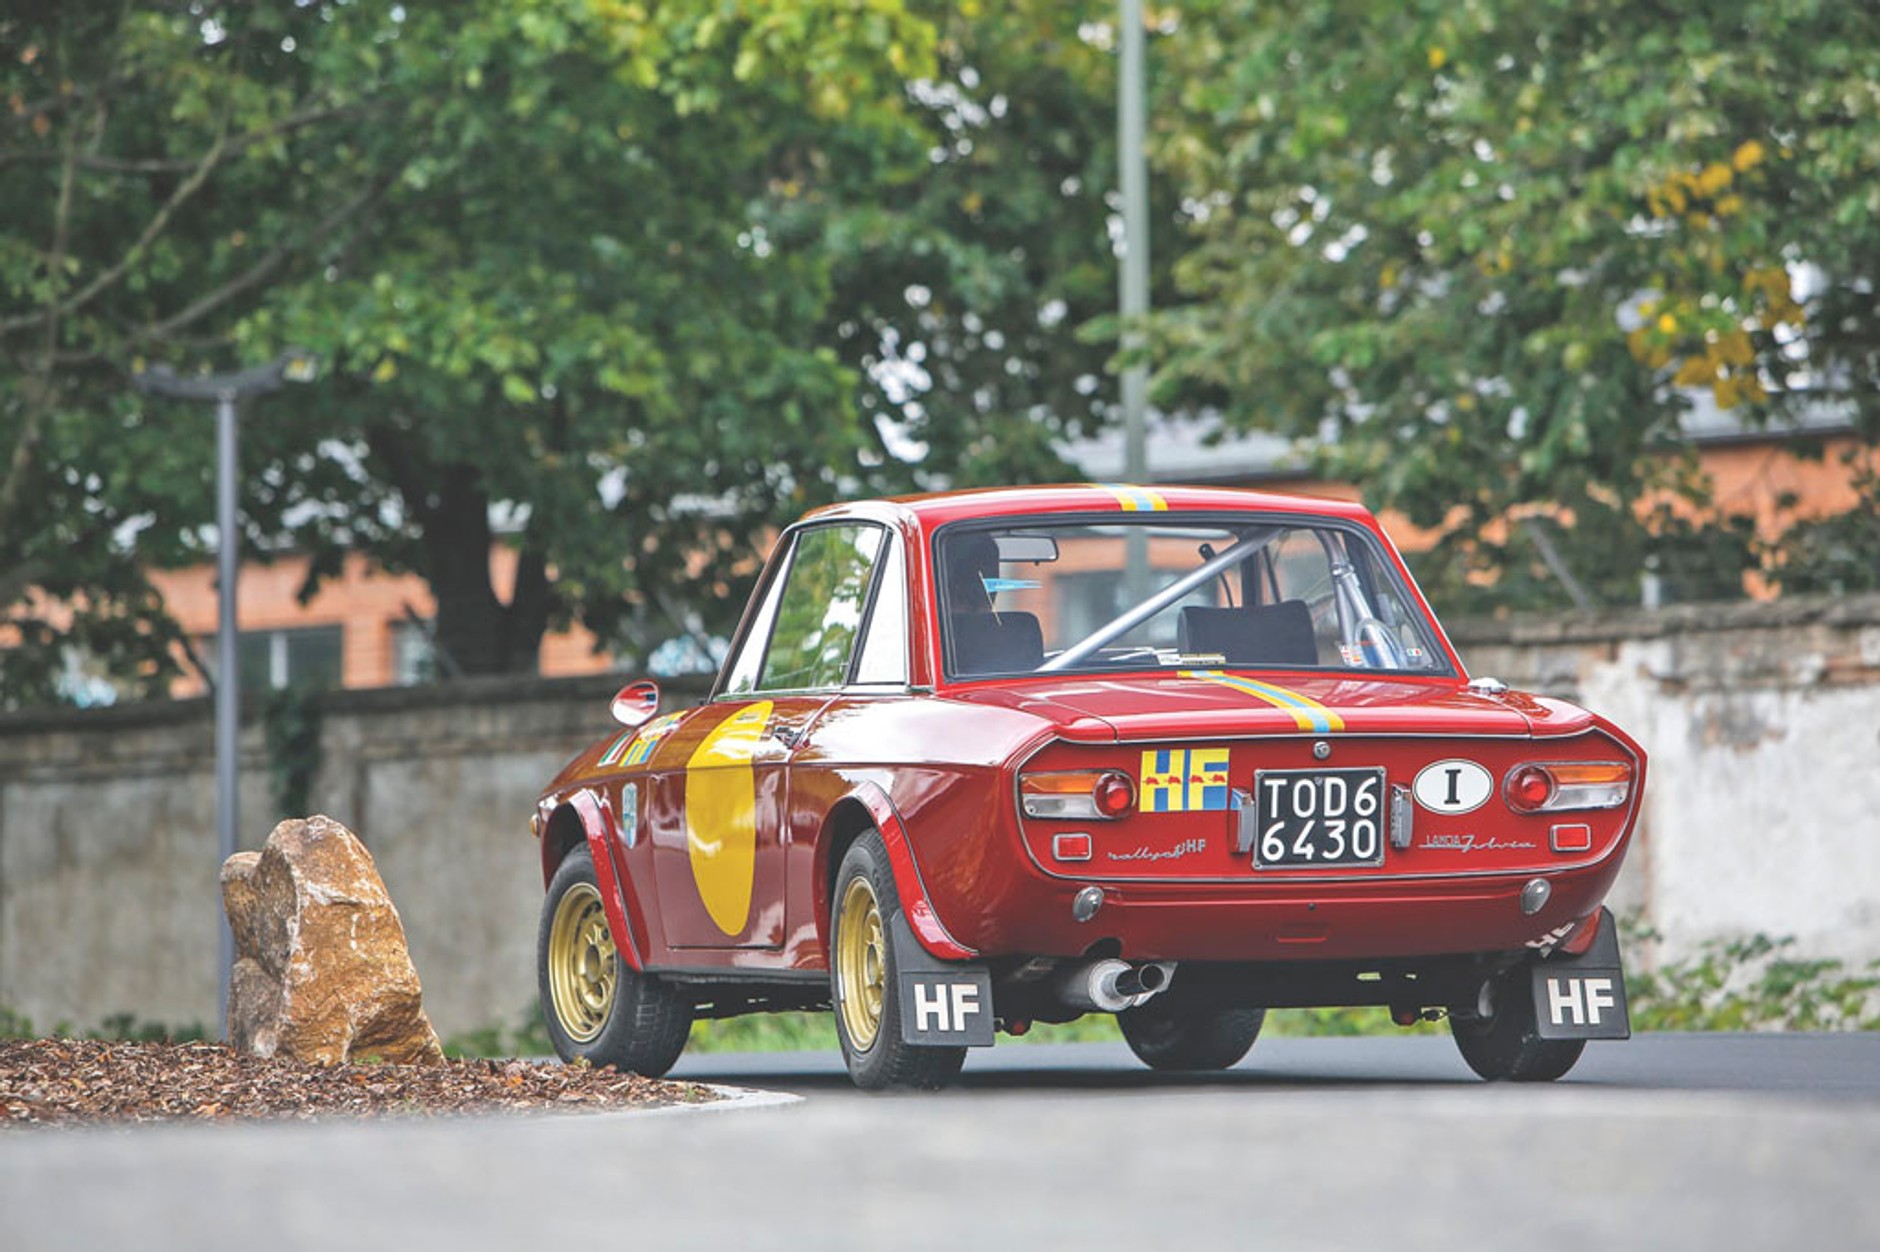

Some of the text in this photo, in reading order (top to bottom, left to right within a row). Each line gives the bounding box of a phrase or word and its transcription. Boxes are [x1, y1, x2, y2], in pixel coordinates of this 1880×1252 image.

[1139, 748, 1230, 813] HF
[1444, 769, 1462, 805] I
[1261, 819, 1377, 861] 6430
[914, 983, 980, 1032] HF
[1547, 978, 1614, 1025] HF
